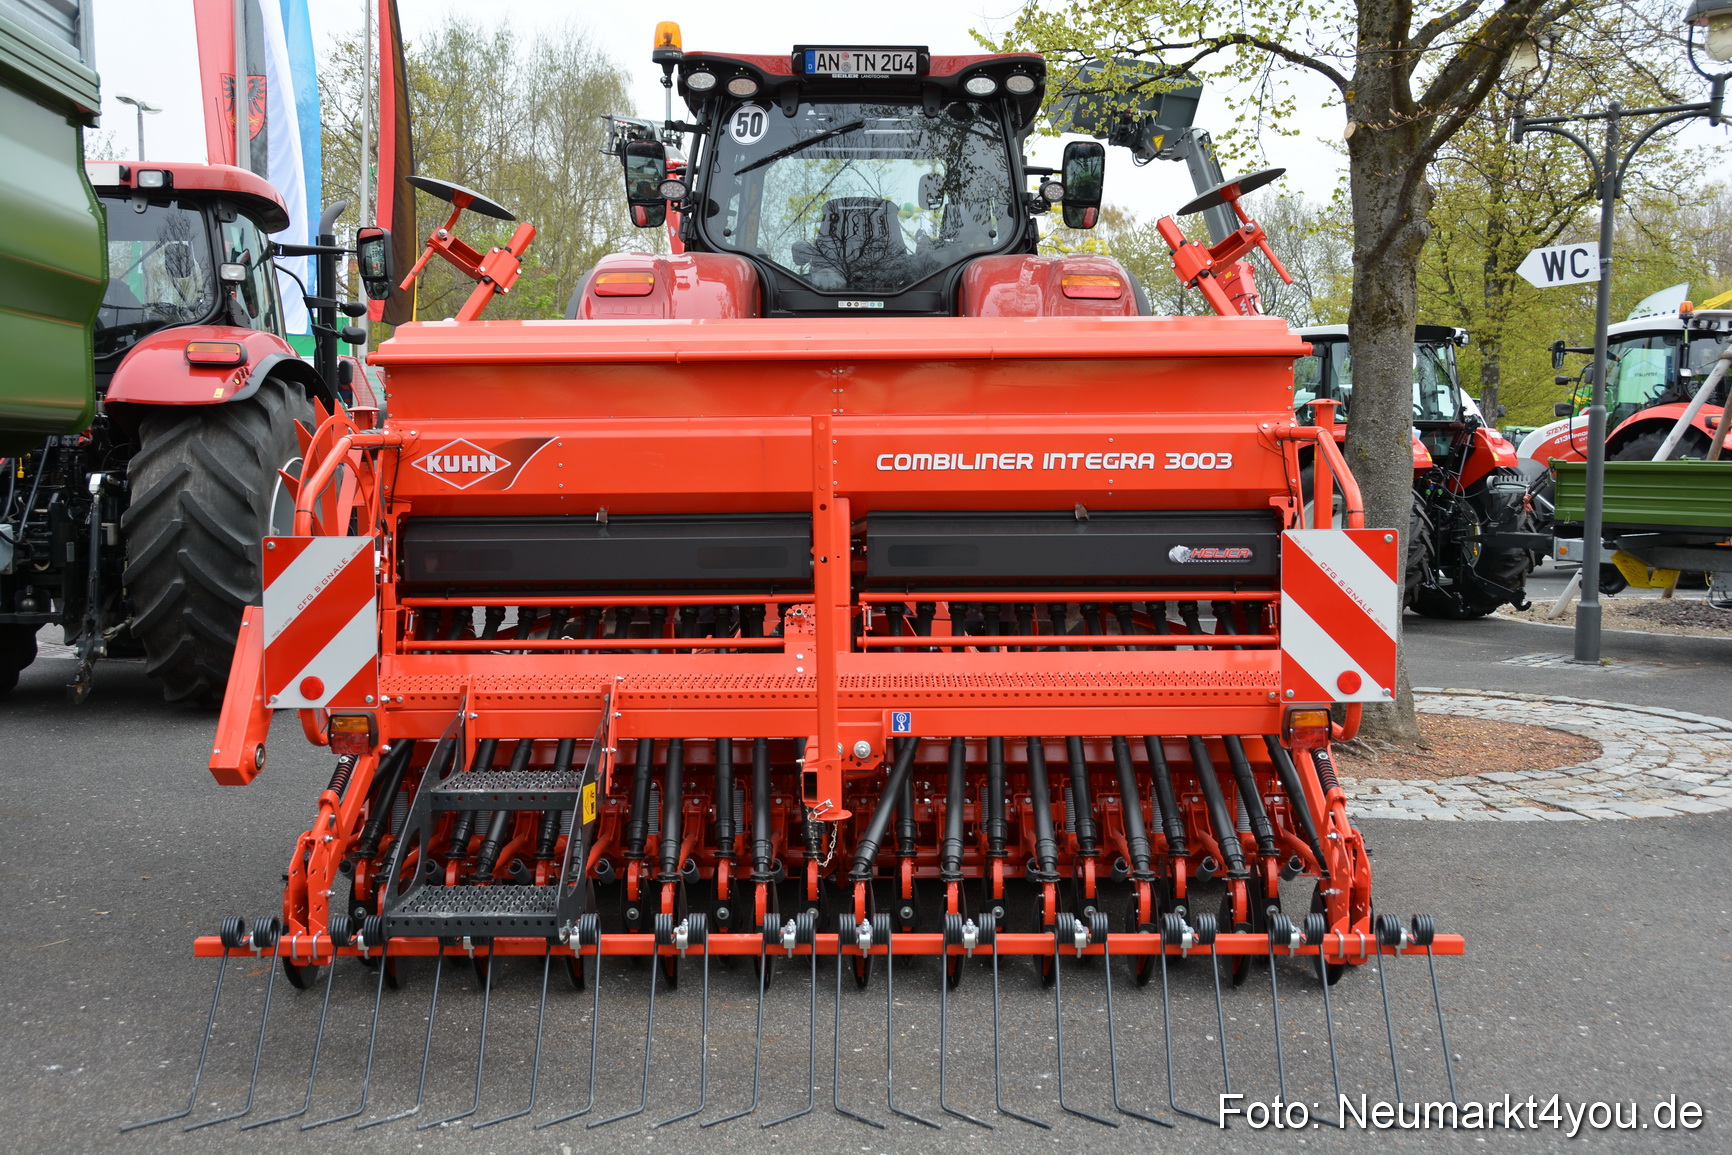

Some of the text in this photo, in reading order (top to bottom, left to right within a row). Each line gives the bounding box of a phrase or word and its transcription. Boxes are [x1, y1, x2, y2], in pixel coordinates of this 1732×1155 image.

[817, 54, 839, 71] AN
[853, 54, 875, 71] TN
[881, 54, 914, 71] 204
[736, 112, 763, 137] 50
[1541, 248, 1589, 282] WC
[1546, 424, 1570, 437] STEYR
[426, 455, 496, 473] KUHN
[876, 452, 1233, 471] COMBILINER INTEGRA 3003
[1191, 548, 1250, 558] HELICA
[1320, 562, 1337, 579] CFG
[297, 593, 314, 611] CFG
